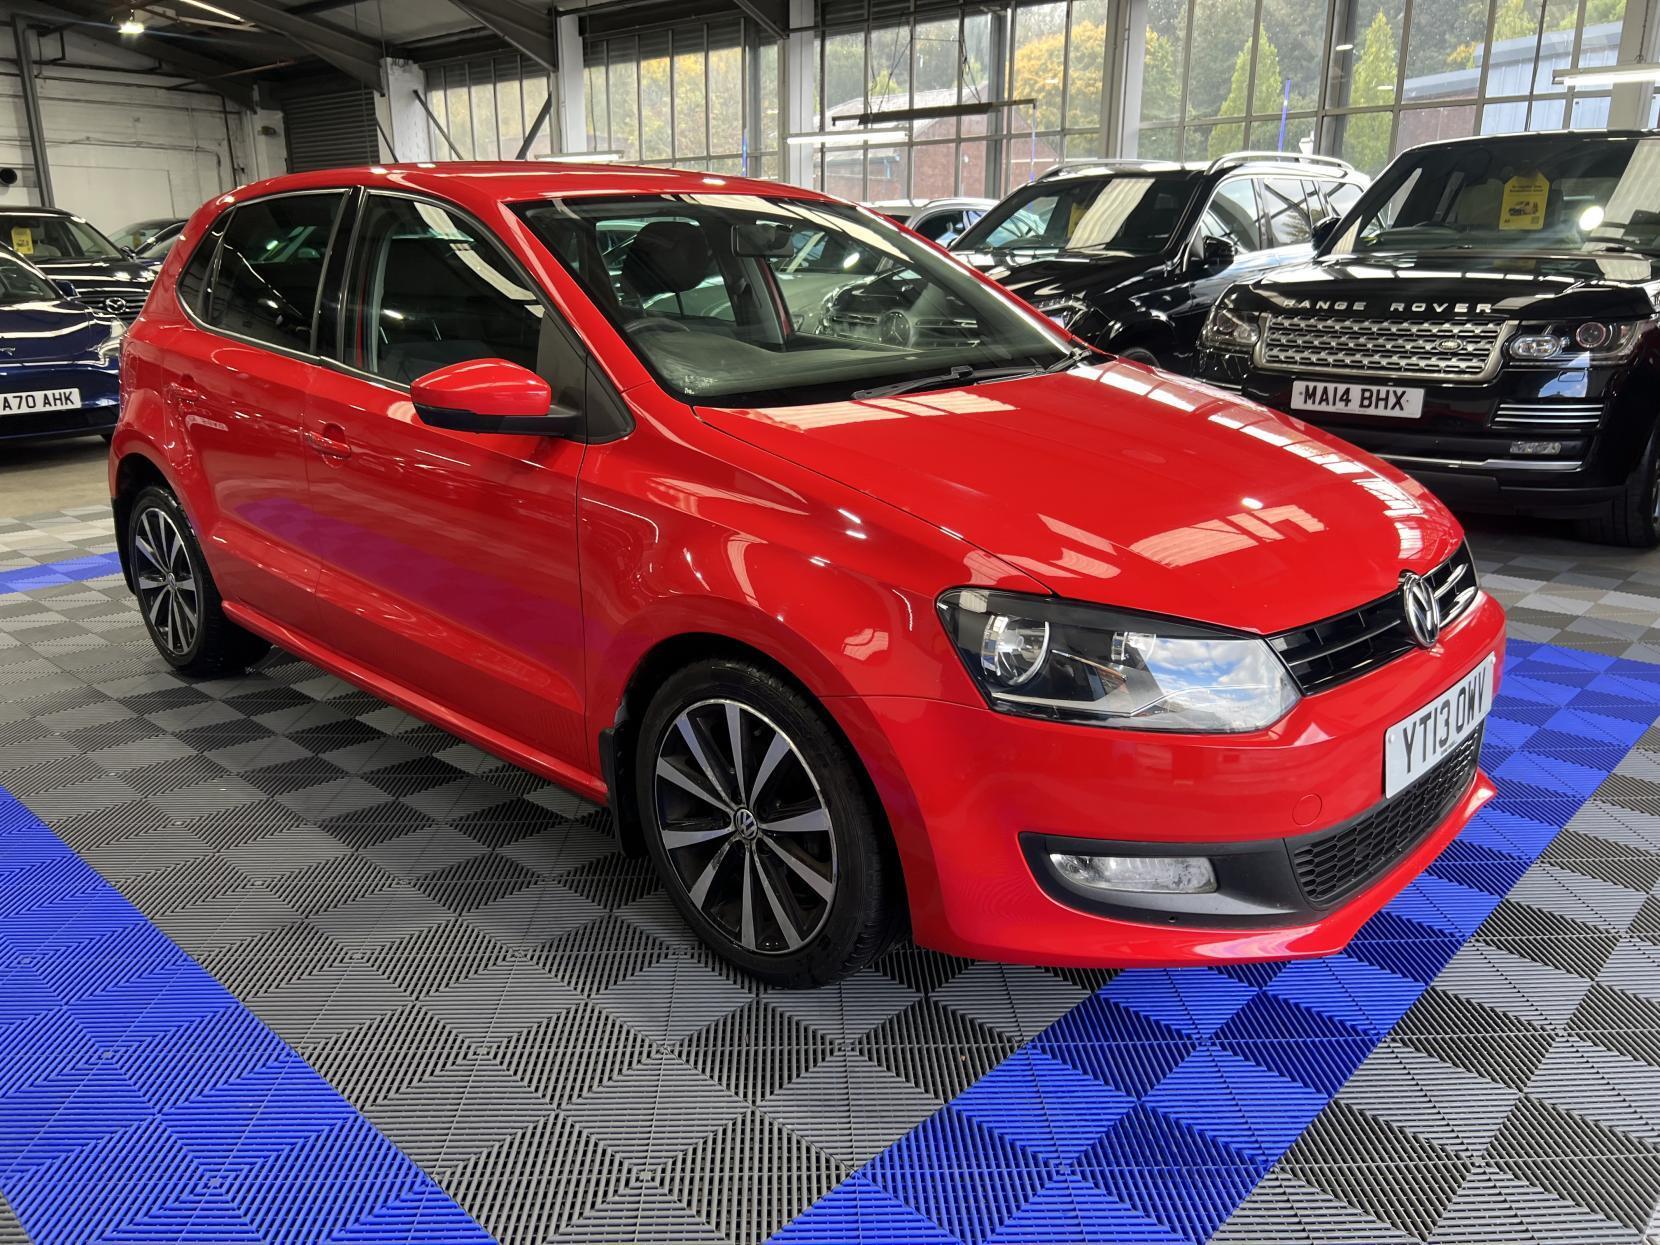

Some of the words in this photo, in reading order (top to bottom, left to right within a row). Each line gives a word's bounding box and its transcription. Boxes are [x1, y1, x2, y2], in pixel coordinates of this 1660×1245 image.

[1282, 300, 1367, 311] RANGE
[1390, 302, 1492, 313] ROVER
[2, 394, 37, 411] A70
[43, 391, 75, 407] AHK
[1303, 385, 1352, 407] MA14
[1359, 388, 1406, 411] BHX
[1402, 698, 1451, 774] YT13
[1455, 666, 1486, 734] OWV
